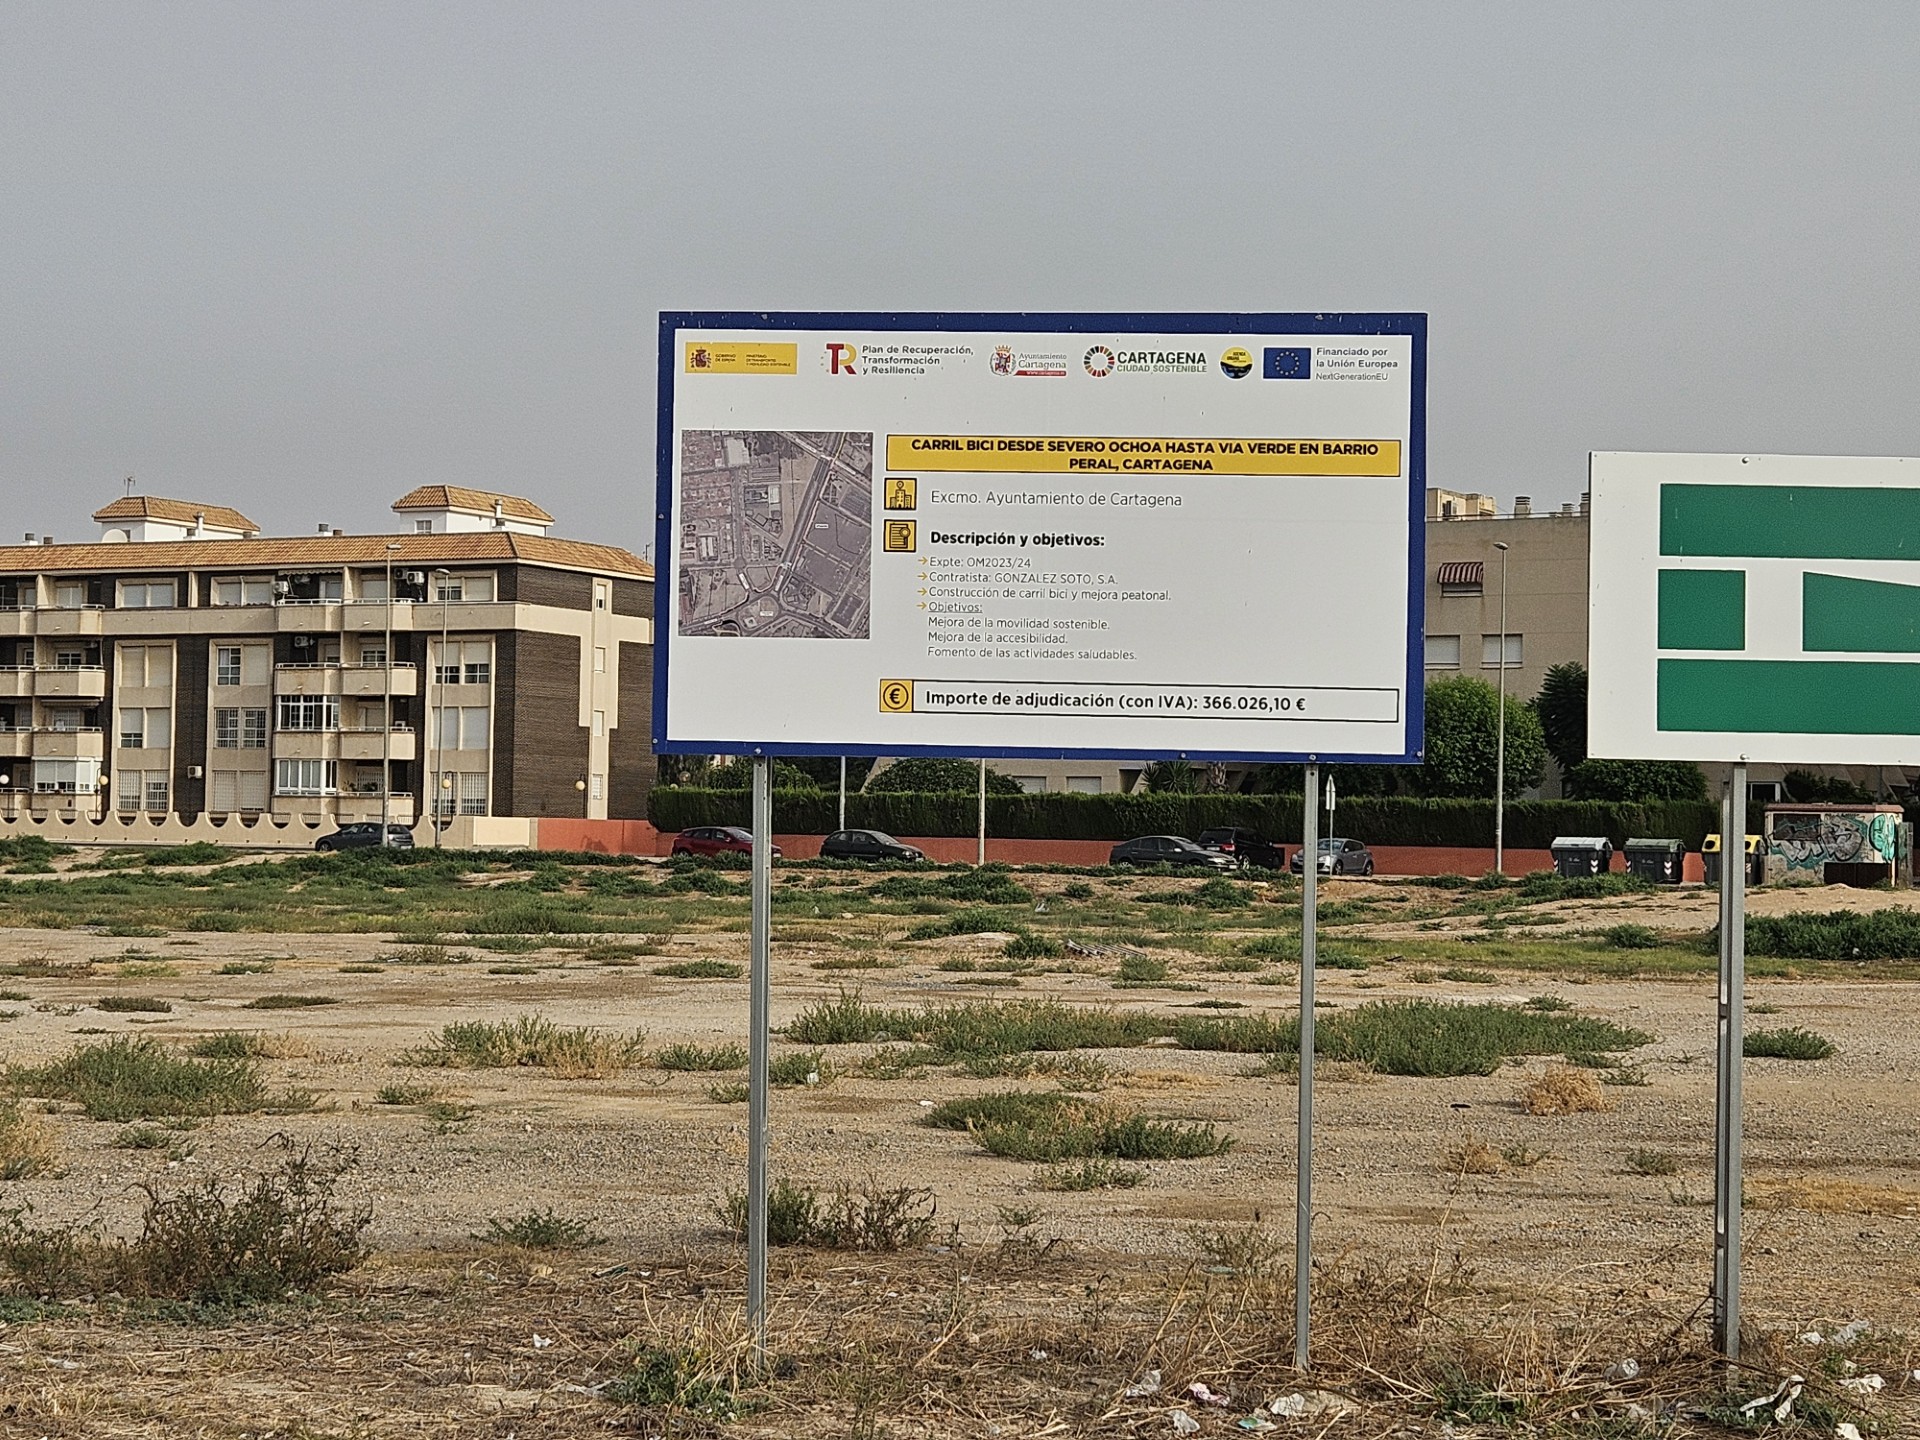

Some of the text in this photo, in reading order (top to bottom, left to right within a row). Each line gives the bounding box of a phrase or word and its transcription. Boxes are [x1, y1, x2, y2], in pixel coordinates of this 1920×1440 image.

[861, 345, 973, 358] Plan de Recuperación,
[1019, 353, 1067, 361] Ayuntamiento
[1117, 351, 1206, 365] CARTAGENA
[1316, 347, 1388, 359] Financiado por
[861, 356, 940, 365] Transformación
[1018, 360, 1066, 370] Cartagena
[1316, 358, 1398, 371] la Unión Europea
[862, 366, 925, 376] y Resiliencia
[1116, 364, 1207, 373] CIUDAD SOSTENIBLE
[1315, 372, 1388, 381] NextGenerationEU
[912, 440, 1378, 455] CARRIL BICI DESDE SEVERO OCHOA HASTA VIA VERDE EN BARRIO
[1069, 458, 1213, 472] PERAL, CARTAGENA
[931, 491, 1182, 508] Excmo. Ayuntamiento de Cartagena
[930, 532, 1105, 547] Descripción y objetivos:
[930, 557, 1031, 569] Expte: OM2023/24
[929, 572, 1118, 585] Contratista: GONZALEZ SOTO, S.A.
[928, 587, 1172, 602] Construcción de carril bici y mejora peatonal.
[928, 602, 983, 614] Objetivos:
[928, 617, 1110, 630] Mejora de la movilidad sostenible.
[928, 632, 1068, 644] Mejora de la accesibilidad.
[928, 646, 1137, 660] Fomento de las actividades saludables.
[926, 691, 1306, 712] Importe de adjudicación (con IVA): 366.026,10 €
